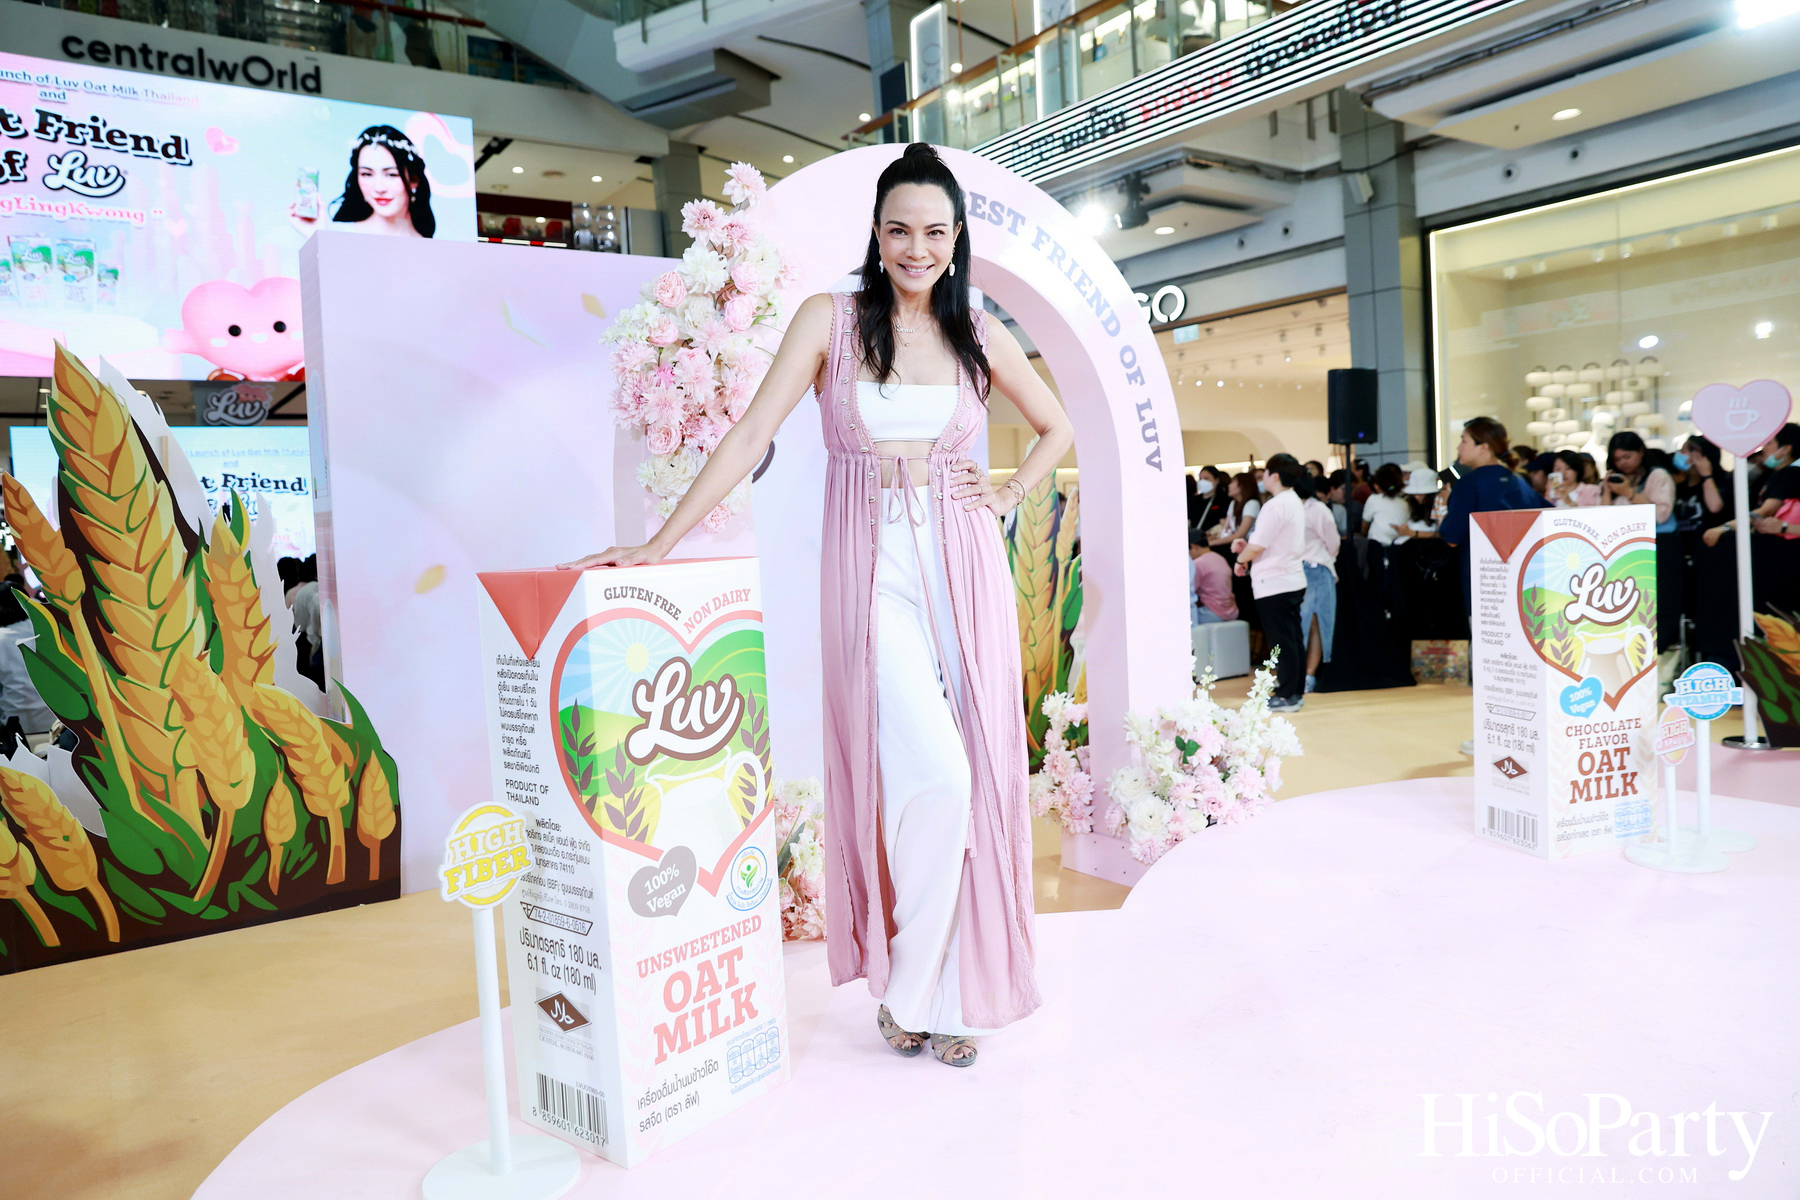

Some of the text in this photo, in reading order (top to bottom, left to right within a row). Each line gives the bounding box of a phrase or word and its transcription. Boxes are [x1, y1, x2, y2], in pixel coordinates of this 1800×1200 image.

[36, 74, 51, 84] of
[55, 76, 79, 89] Luv
[84, 81, 107, 92] Oat
[112, 84, 139, 97] Milk
[39, 89, 67, 101] and
[34, 108, 189, 163] Friend
[43, 150, 126, 198] Luv
[963, 191, 1163, 473] EST FRIEND OF LUV
[206, 390, 267, 425] Luv
[221, 472, 308, 495] Friend
[1553, 518, 1648, 549] GLUTEN FREE NON DAIRY
[603, 586, 752, 635] GLUTEN FREE NON DAIRY
[1564, 562, 1640, 626] Luv
[1568, 686, 1592, 702] 100%
[1677, 676, 1729, 695] HIGH
[625, 656, 745, 766] Luv
[1569, 700, 1596, 715] Vegan
[1566, 717, 1642, 738] CHOCOLATE
[1579, 733, 1629, 750] FLAVOR
[1577, 746, 1631, 776] OAT
[505, 778, 549, 795] PRODUCT OF
[506, 791, 540, 806] THAILAND
[1569, 771, 1638, 804] MILK
[451, 821, 523, 864] HIGH
[444, 846, 531, 895] FIBER
[644, 863, 680, 896] 100%
[646, 883, 687, 913] Vegan
[519, 926, 602, 971] ปริมาตรสุทธิ 180 มล.
[637, 914, 763, 979] UNSWEETENED
[527, 952, 597, 996] 6.1 fl. oz (180 ml)
[663, 945, 744, 1013] OAT
[653, 981, 759, 1065] MILK
[637, 1058, 719, 1111] เครื่องดื่มน้ำนมข้าวโอ๊ต
[532, 1106, 606, 1148] 8 859601 623017
[639, 1090, 700, 1133] รสจืด (ตรา ลัฟ)
